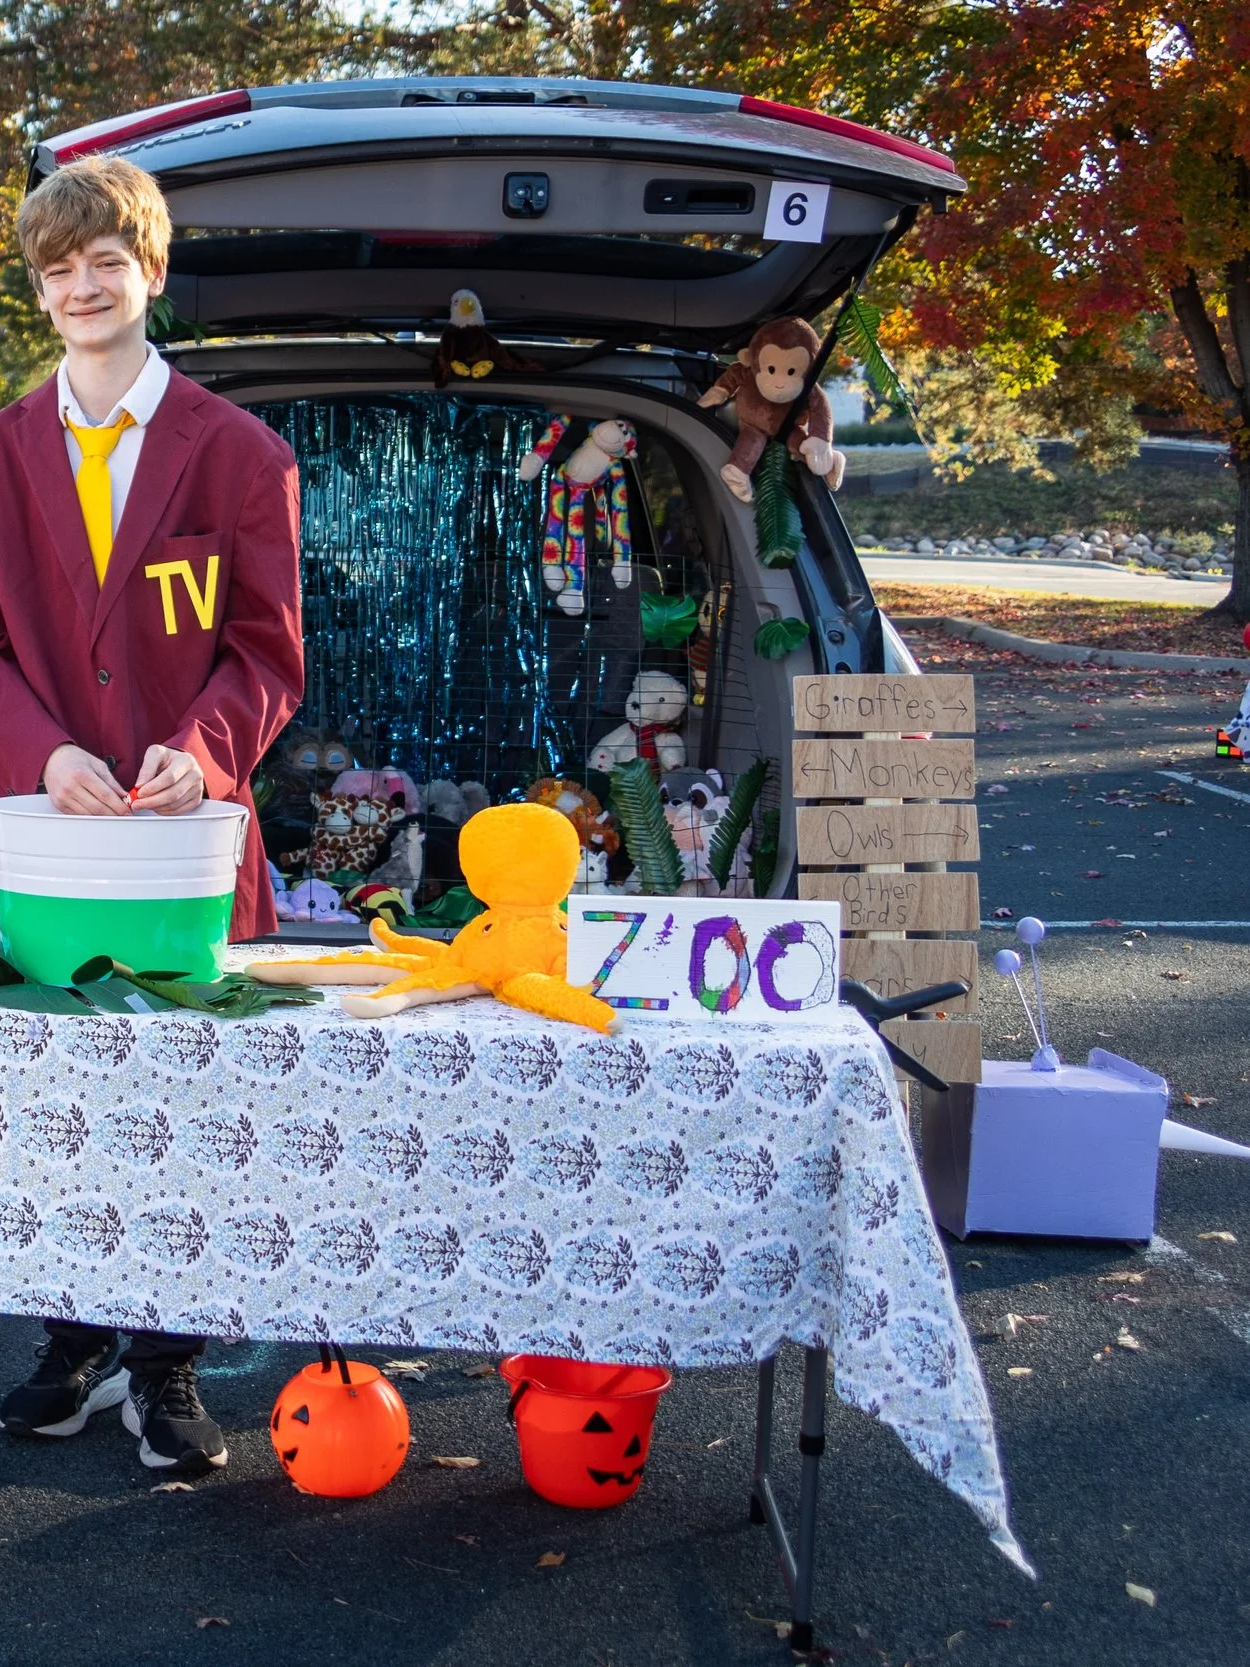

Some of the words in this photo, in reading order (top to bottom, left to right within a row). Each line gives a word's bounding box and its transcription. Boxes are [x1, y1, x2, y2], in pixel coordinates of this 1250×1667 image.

[782, 192, 808, 226] 6
[144, 555, 220, 635] TV
[805, 682, 936, 721] Giraffes
[830, 748, 972, 795] Monkeys
[827, 810, 894, 858] Owls
[843, 874, 918, 902] Other
